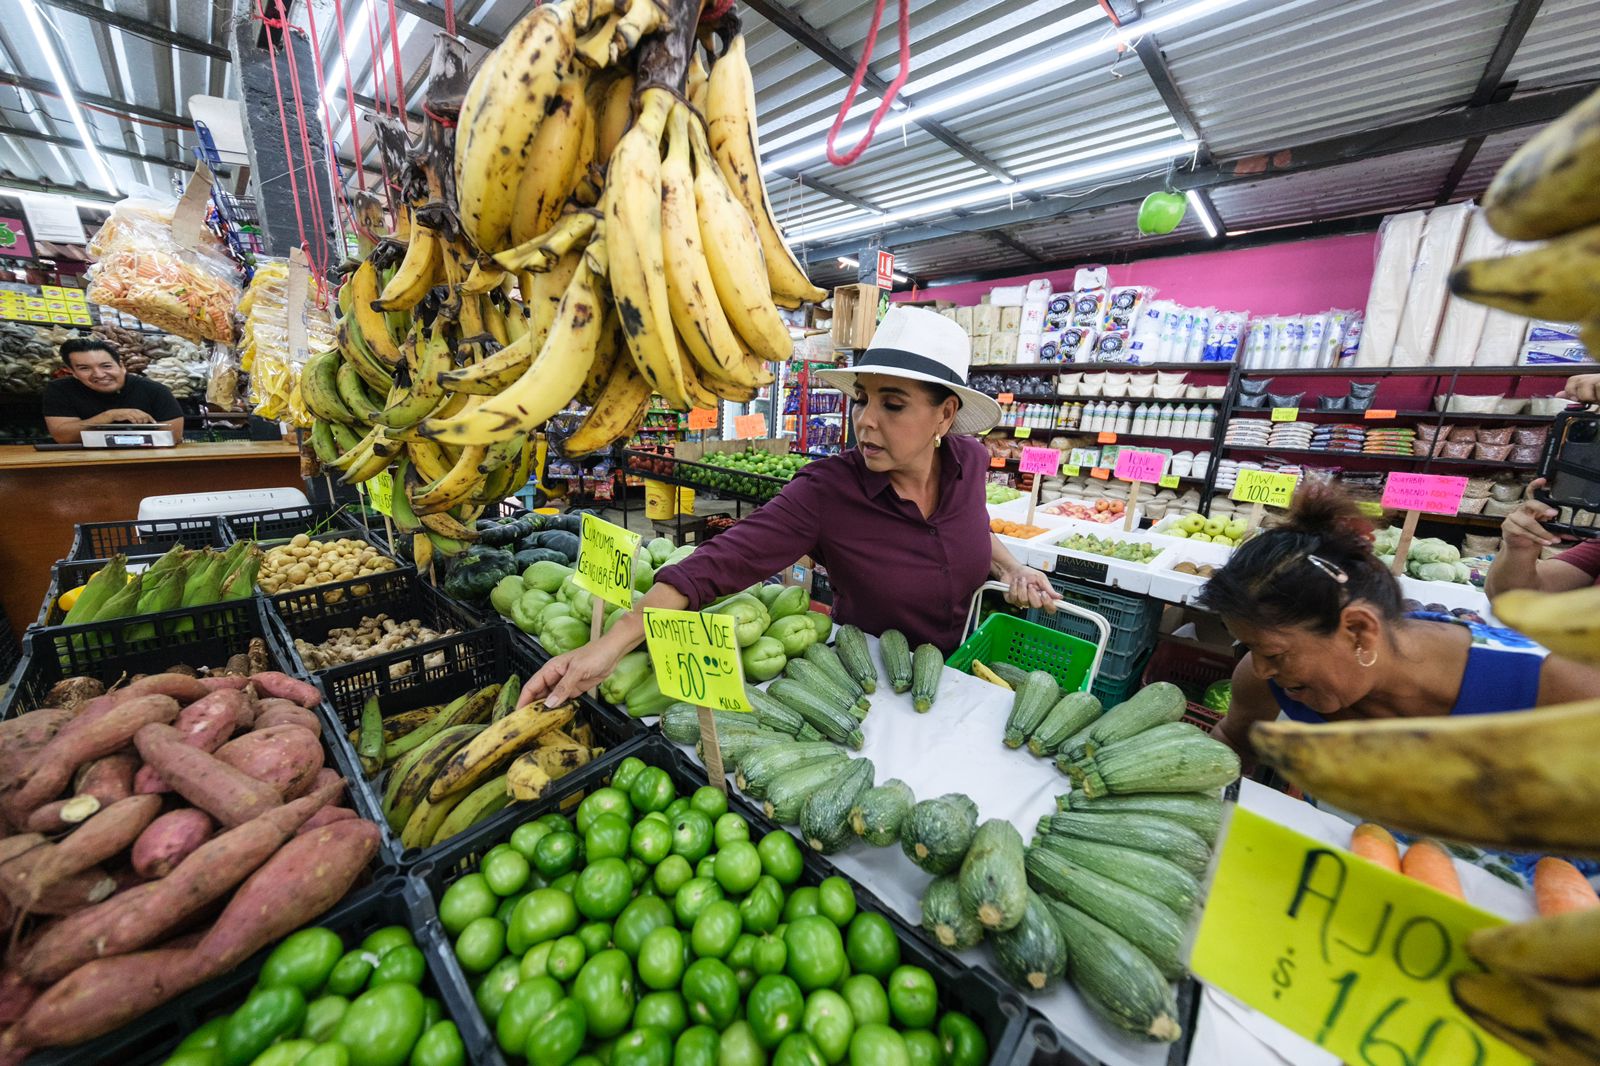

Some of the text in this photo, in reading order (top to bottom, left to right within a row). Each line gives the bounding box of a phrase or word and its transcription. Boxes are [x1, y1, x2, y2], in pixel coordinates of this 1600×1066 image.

[1246, 471, 1275, 485] KIWI
[582, 517, 615, 557] CURCUMA
[577, 551, 615, 593] GENGIBRE
[643, 612, 700, 647] TOMATE
[719, 696, 741, 710] KILO
[1287, 848, 1452, 981] AJO
[1271, 947, 1297, 1000] $
